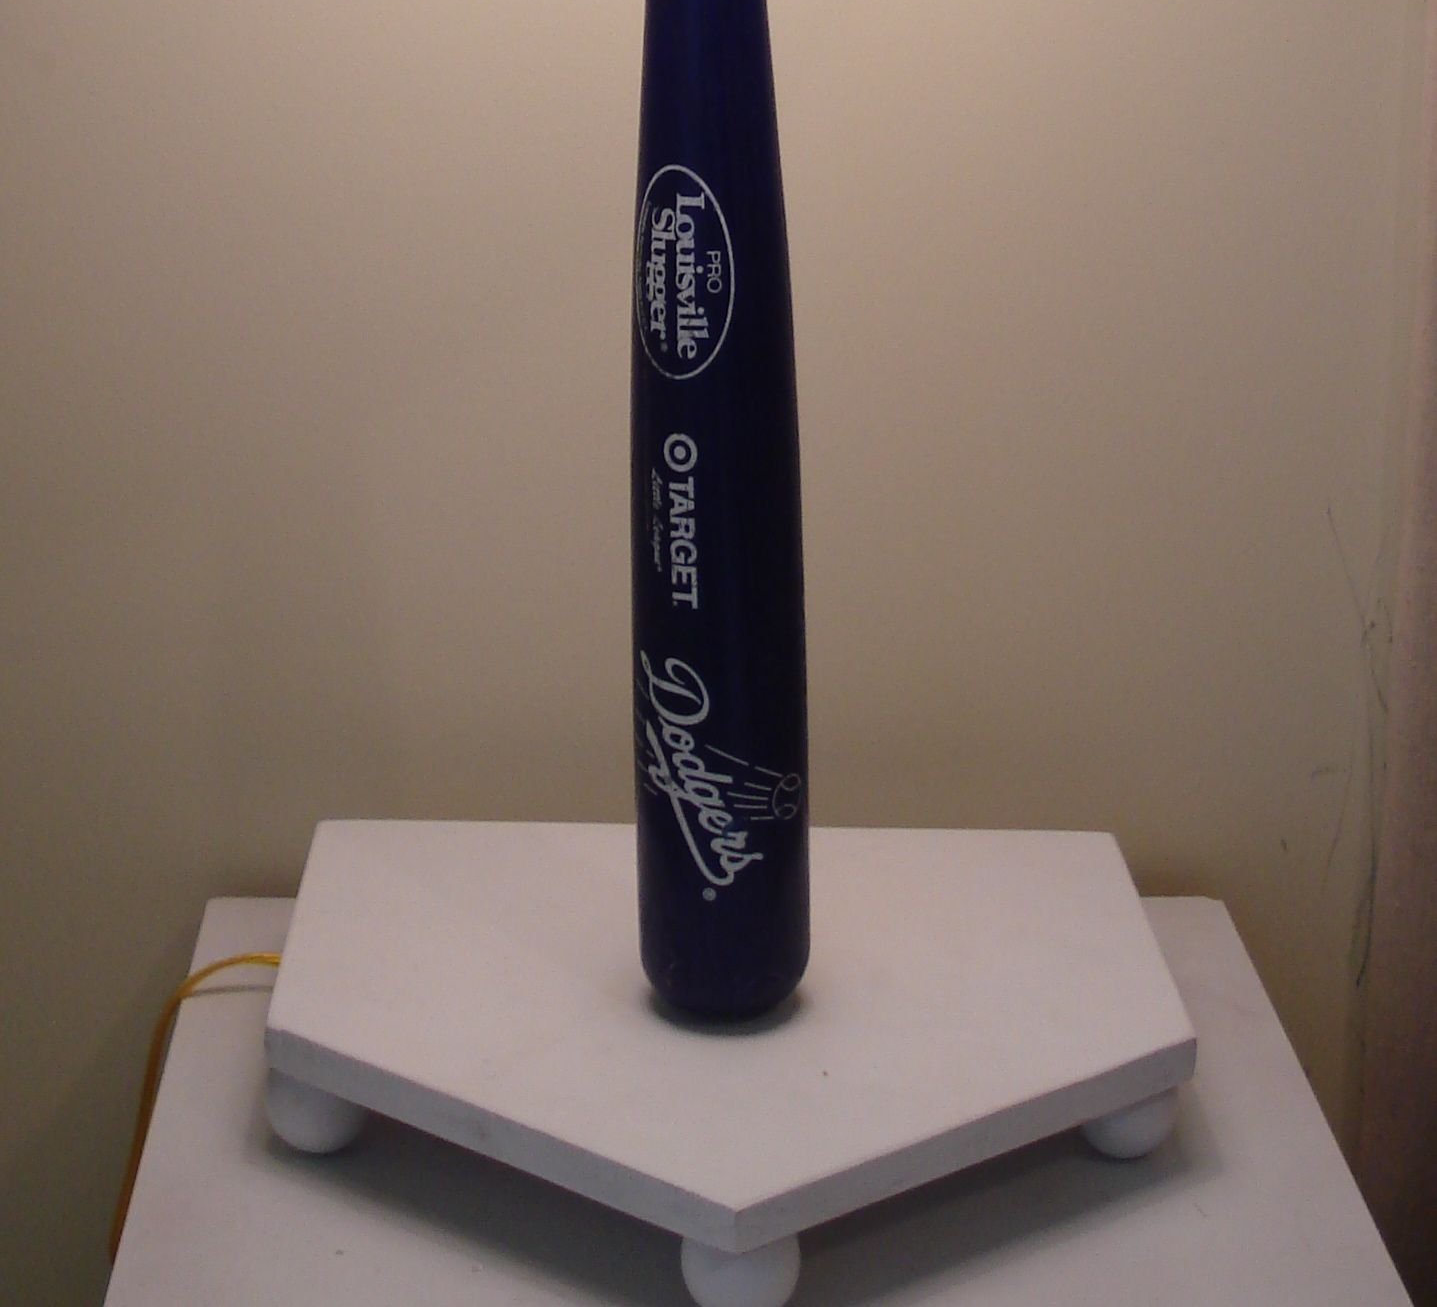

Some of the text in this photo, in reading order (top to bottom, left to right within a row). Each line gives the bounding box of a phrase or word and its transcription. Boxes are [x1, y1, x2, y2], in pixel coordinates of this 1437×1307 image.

[646, 206, 676, 340] Slugger
[676, 192, 710, 360] Louisville
[706, 249, 722, 294] PRO
[640, 649, 764, 886] Dodgers
